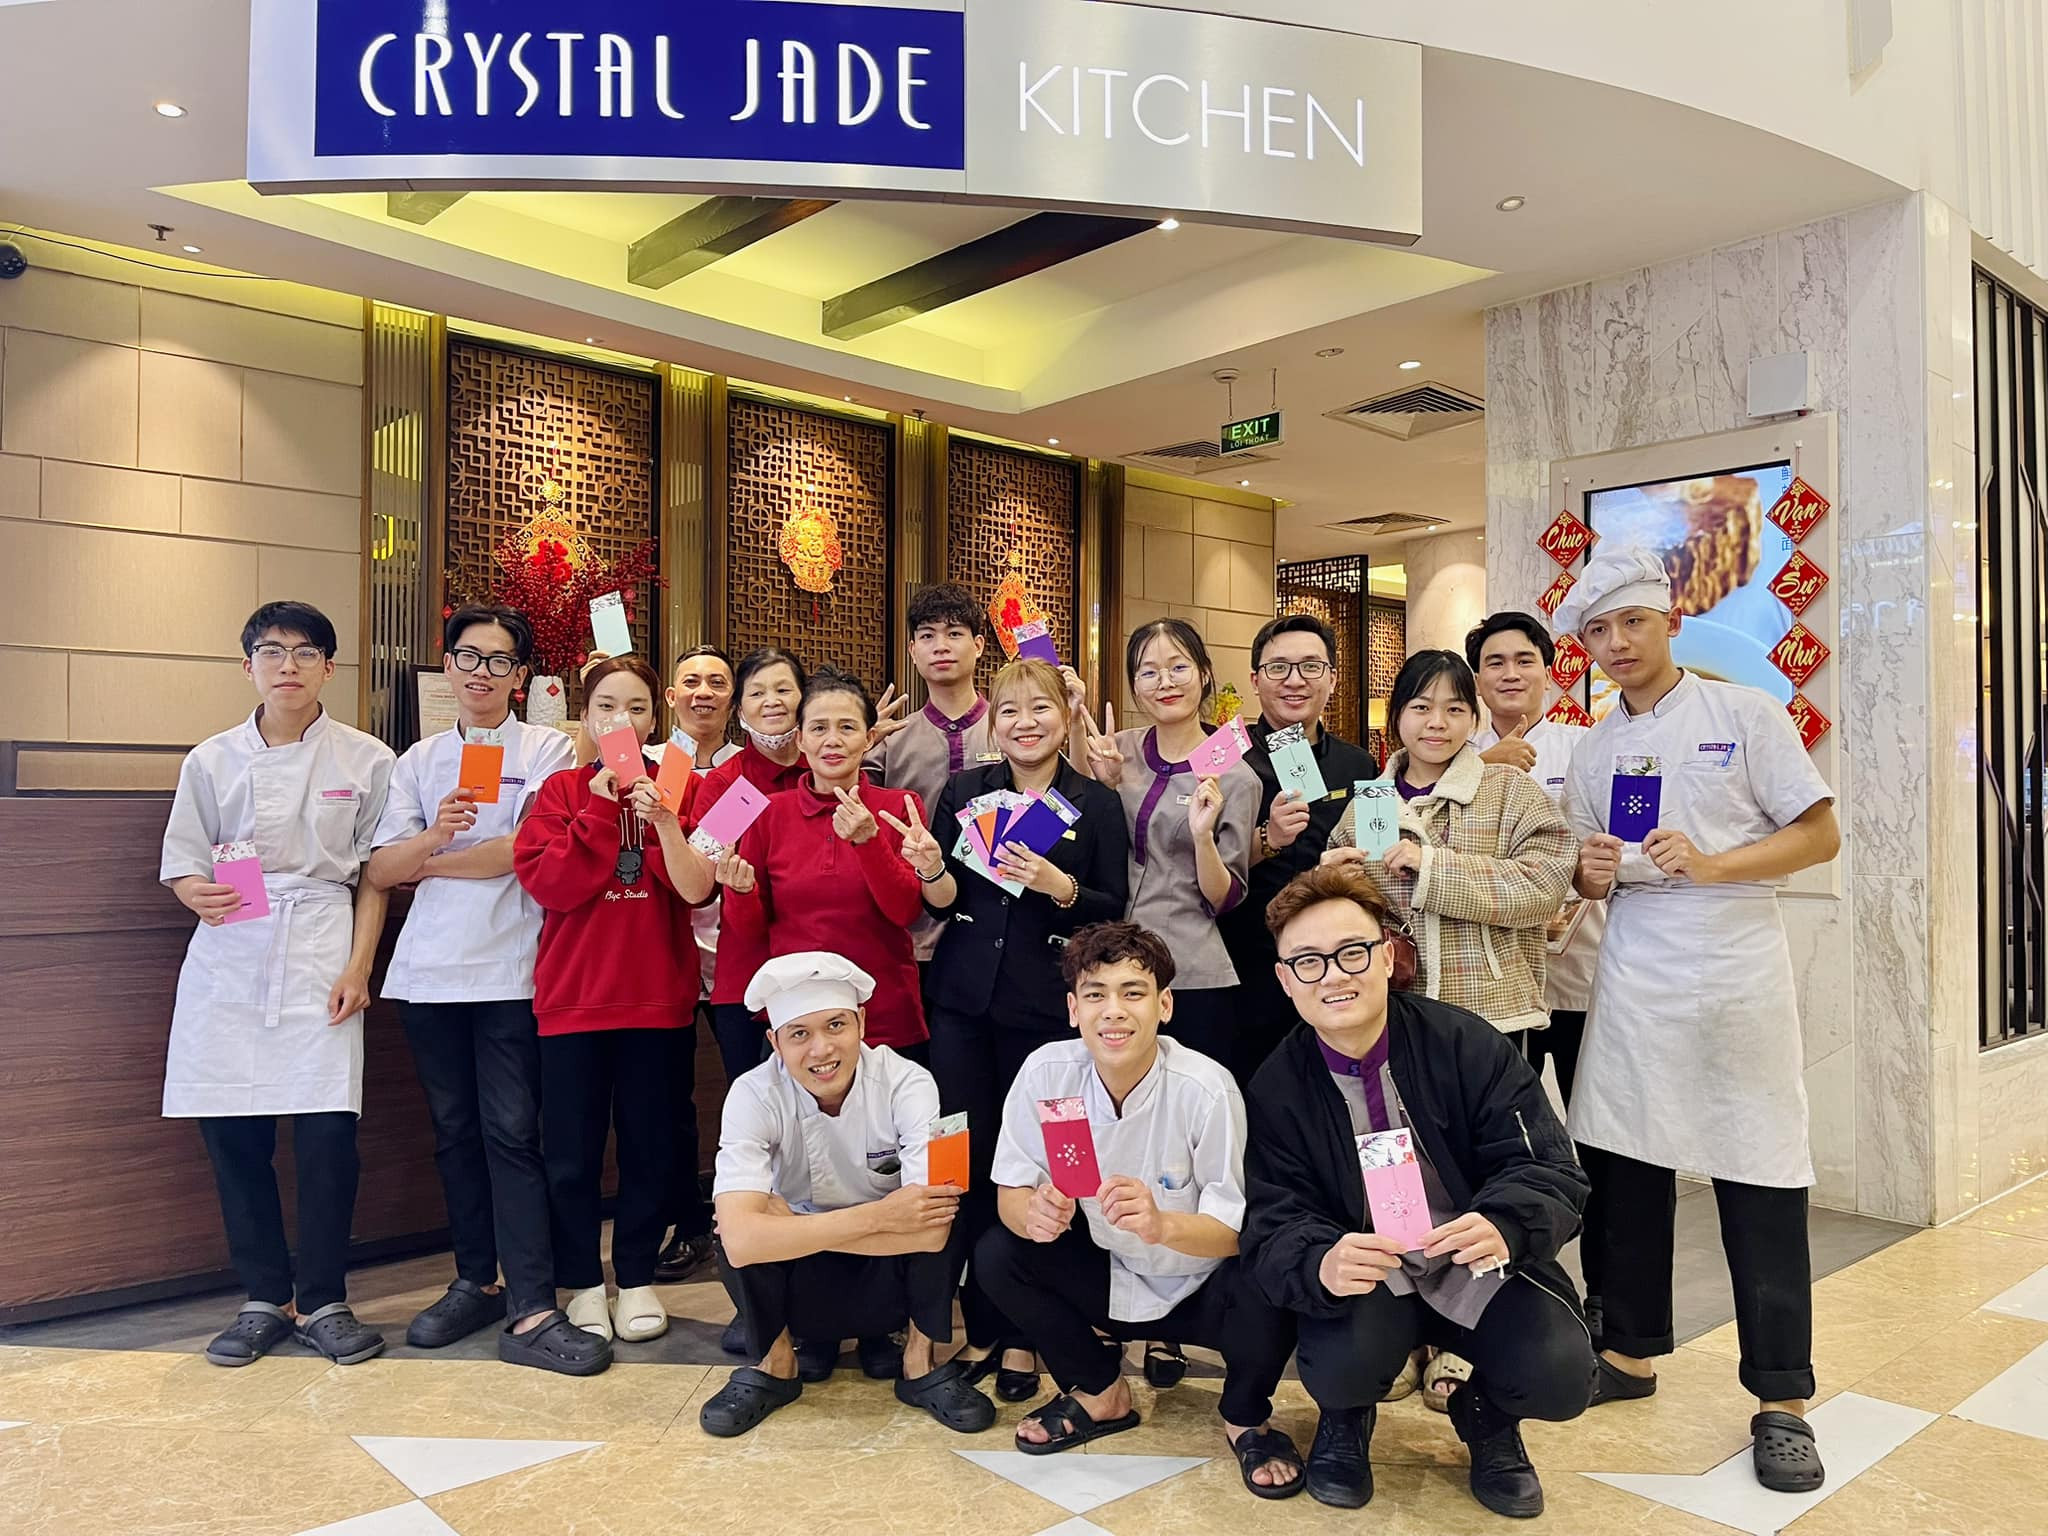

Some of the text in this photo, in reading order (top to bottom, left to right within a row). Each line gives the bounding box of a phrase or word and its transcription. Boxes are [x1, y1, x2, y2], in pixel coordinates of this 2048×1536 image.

[358, 32, 932, 129] CRYSTAL JADE
[1019, 61, 1364, 168] KITCHEN
[1231, 417, 1270, 440] EXIT
[1774, 498, 1819, 526] Vạn
[1546, 525, 1584, 551] Chúc
[1777, 639, 1819, 669] Như
[624, 889, 648, 899] Studio
